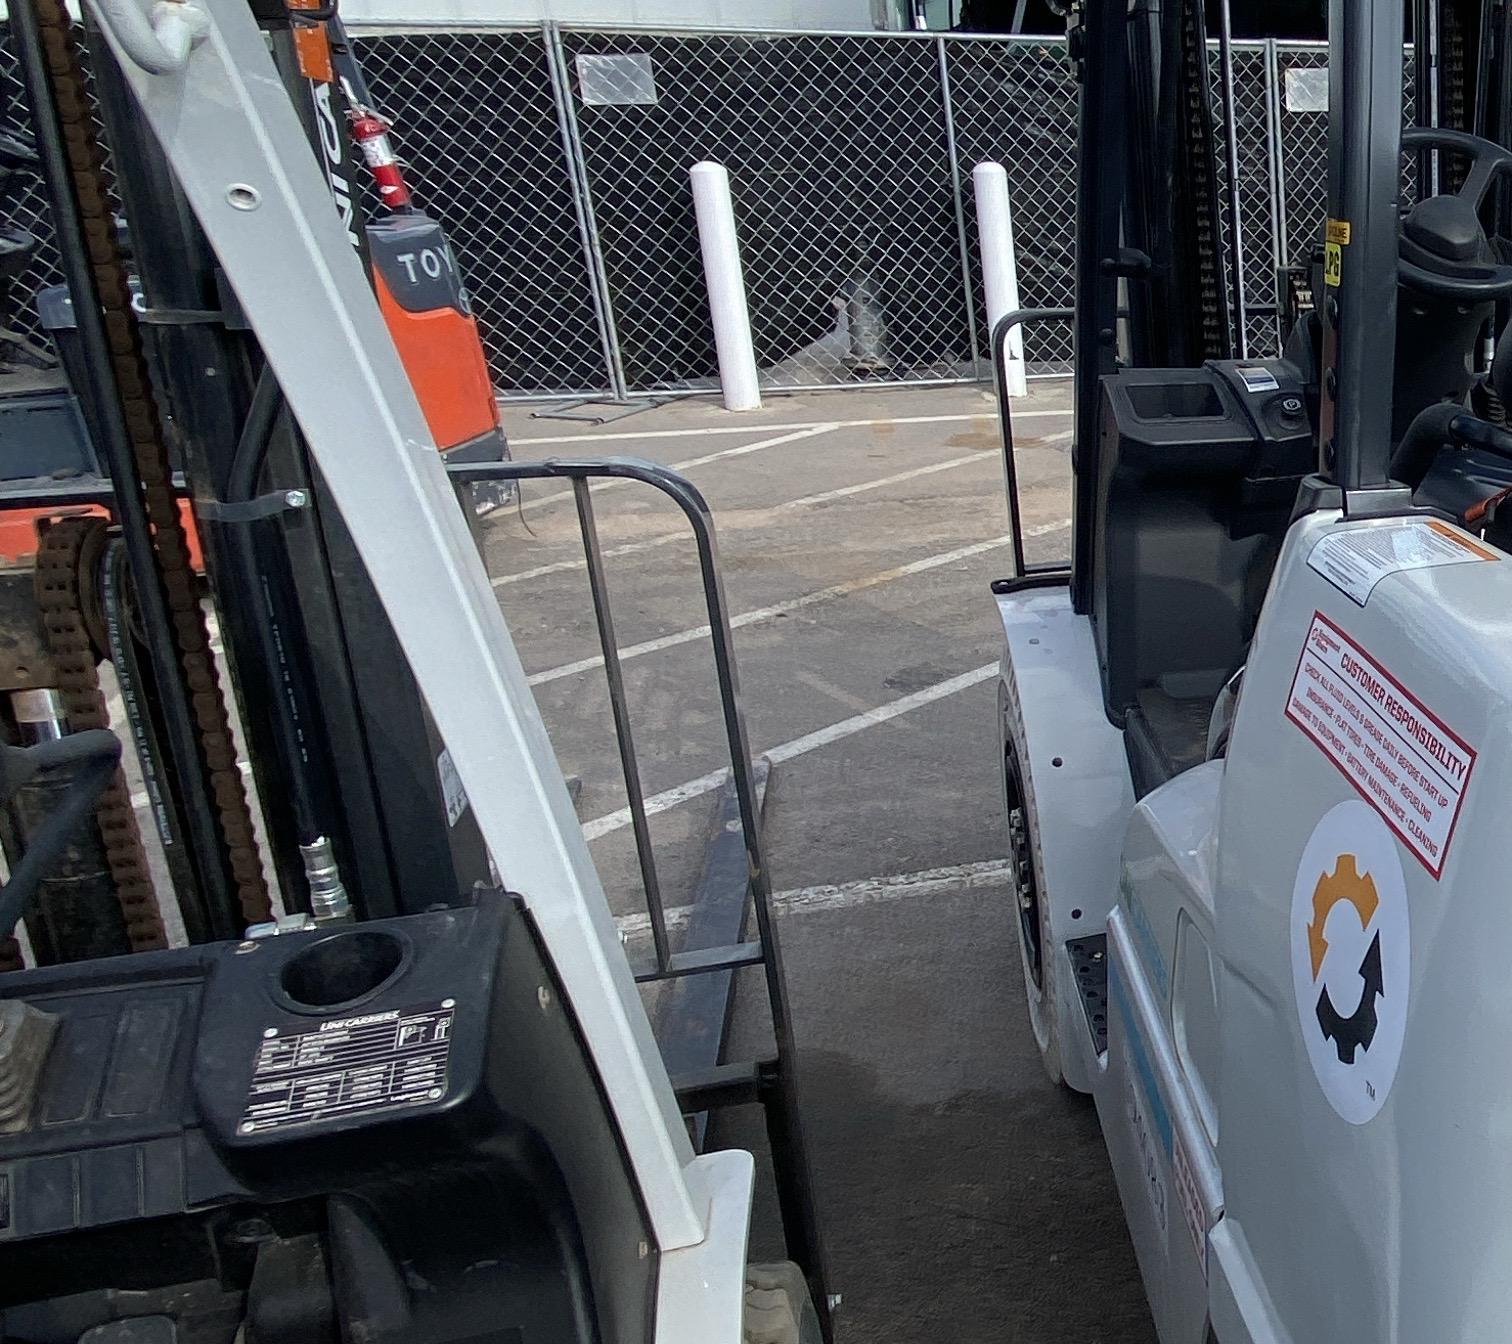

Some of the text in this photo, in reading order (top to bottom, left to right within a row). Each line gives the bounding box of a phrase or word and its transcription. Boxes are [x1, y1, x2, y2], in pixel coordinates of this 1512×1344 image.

[1292, 696, 1438, 857] DAMAGE TO EQUIPMENT BATTERY MAINTENANCE CLEANING
[1304, 662, 1320, 682] CHECK
[1320, 677, 1328, 689] ALL
[1328, 684, 1342, 703] FLUID
[1342, 697, 1360, 721] LEVELS
[1363, 718, 1383, 744] GREASE
[1382, 738, 1398, 759] DAILY
[1398, 754, 1419, 781] BEFORE
[1419, 775, 1438, 800] START
[1437, 793, 1448, 810] UP
[1334, 715, 1347, 733] FLAT
[1346, 726, 1361, 748] TIRES
[1363, 744, 1376, 763] TIRE
[1375, 757, 1397, 786] DAMAGE
[1399, 782, 1431, 821] REFUELING
[1340, 652, 1466, 781] CUSTOMER RESPONSIBILITY
